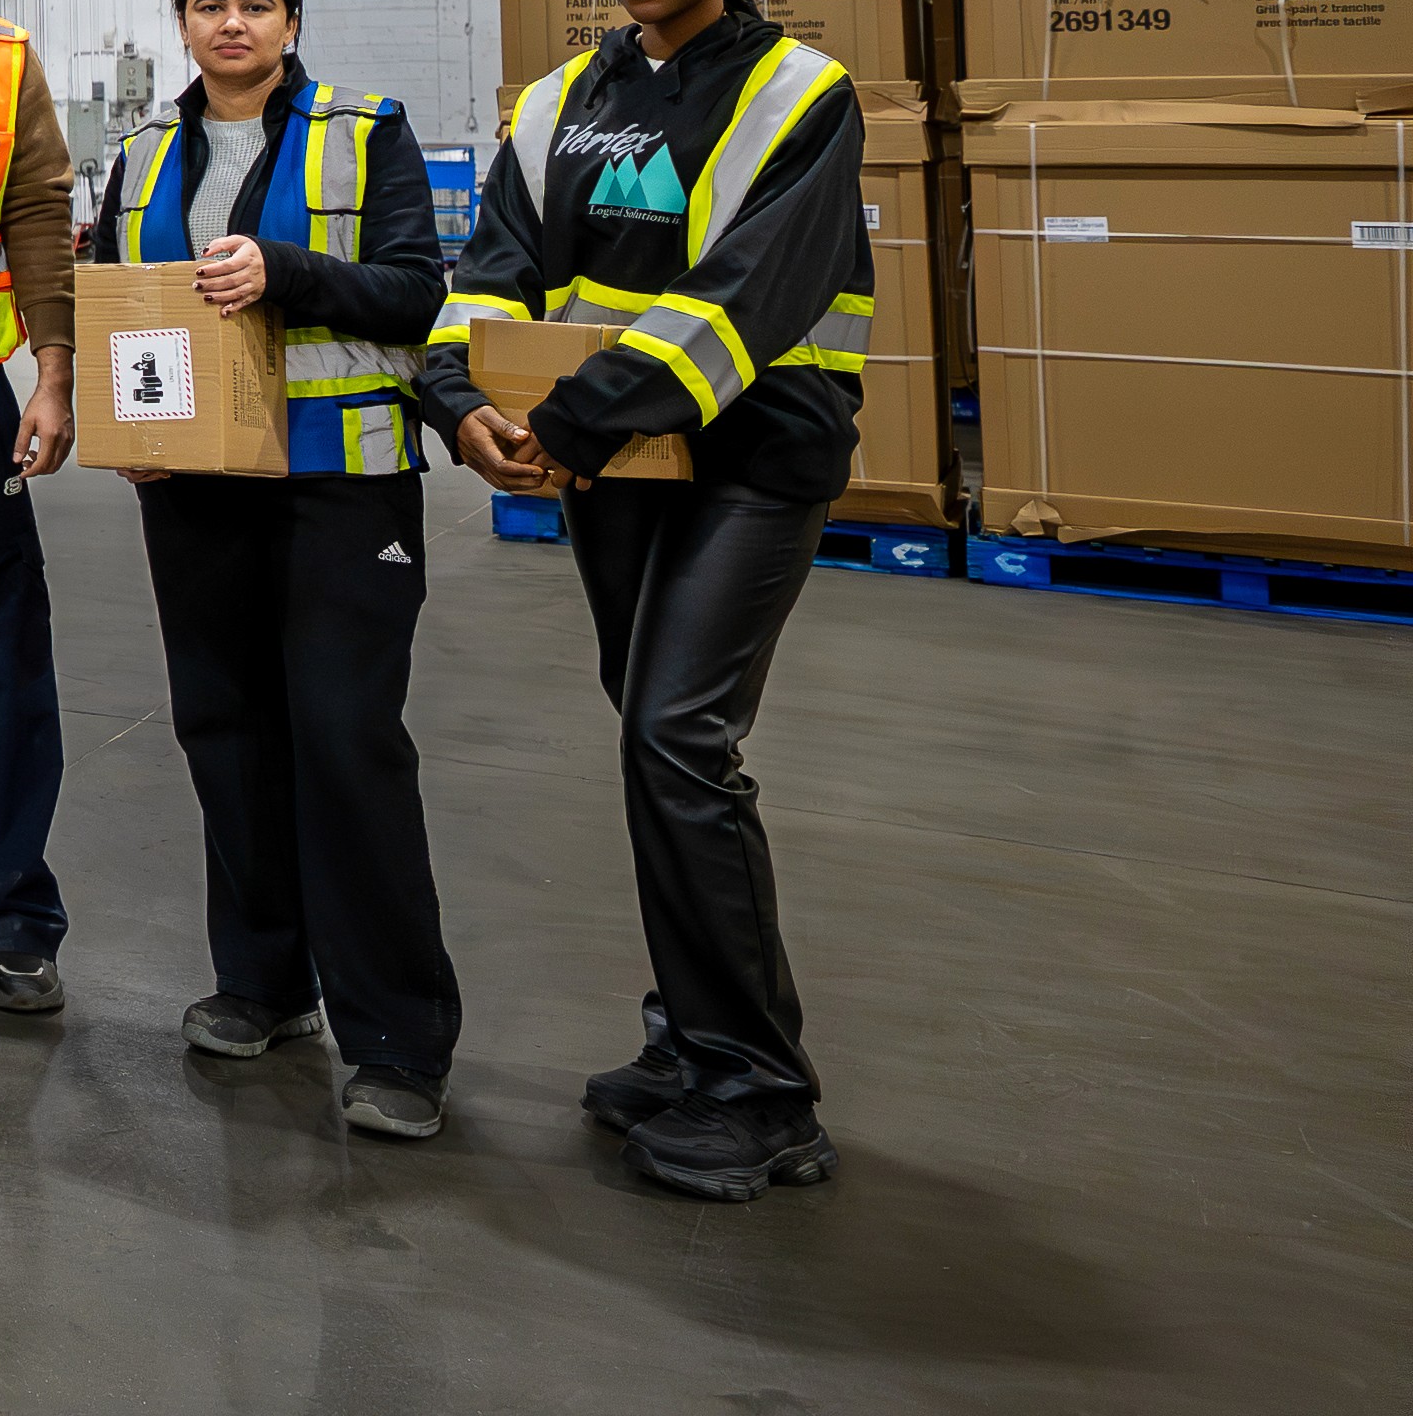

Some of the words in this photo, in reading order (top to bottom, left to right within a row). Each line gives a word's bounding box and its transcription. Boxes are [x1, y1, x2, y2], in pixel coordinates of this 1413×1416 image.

[1256, 4, 1317, 15] Grill-pain
[1331, 3, 1385, 13] tranches
[1050, 8, 1171, 33] 2691349
[1343, 16, 1382, 26] tactile
[555, 121, 663, 162] Vertex
[589, 205, 623, 218] Logical
[623, 208, 670, 223] Solutions
[378, 552, 411, 563] adidas
